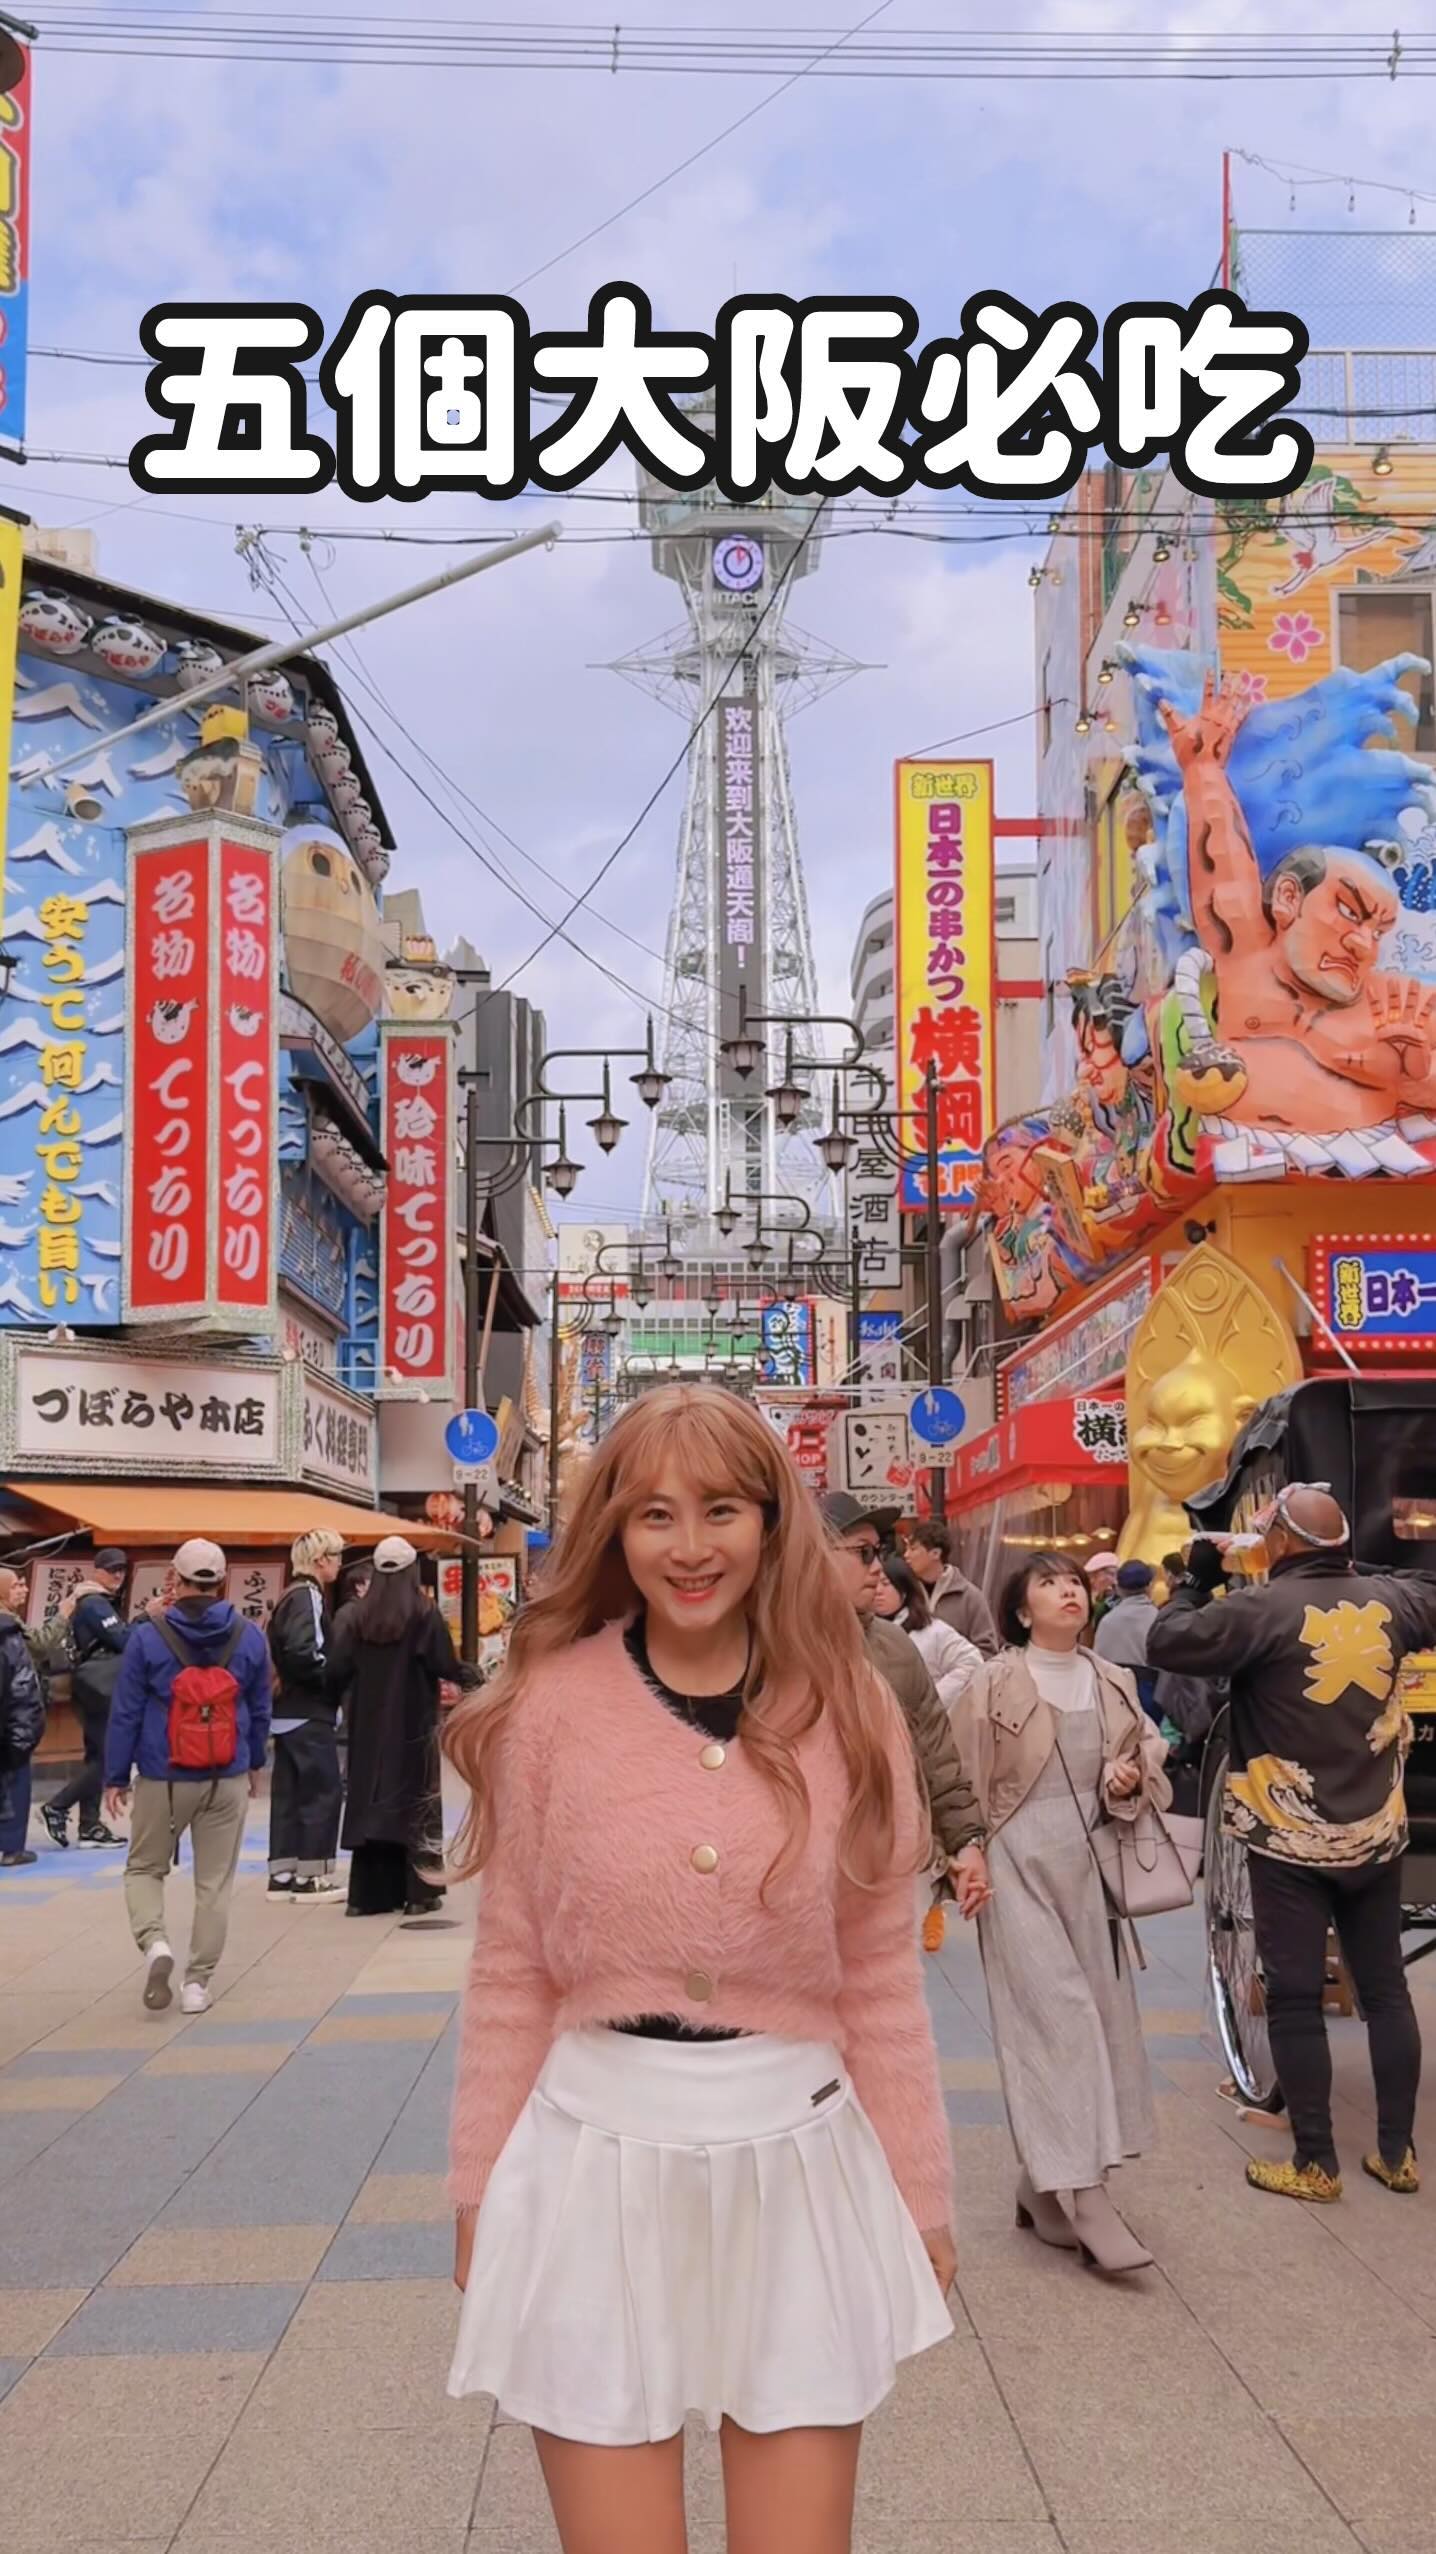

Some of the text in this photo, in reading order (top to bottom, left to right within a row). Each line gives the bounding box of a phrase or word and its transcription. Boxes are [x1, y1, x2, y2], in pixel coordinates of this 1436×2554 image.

[926, 803, 965, 1001] 日本一の串かつ
[37, 893, 89, 1308] 安うて何んでも旨い
[148, 870, 195, 1281] 名物 てっちり
[223, 872, 266, 1281] 名物 てっちり
[910, 1006, 982, 1152] 横綱
[392, 1096, 438, 1368] 珍味てっちり
[32, 1386, 266, 1436] づぼらや本店
